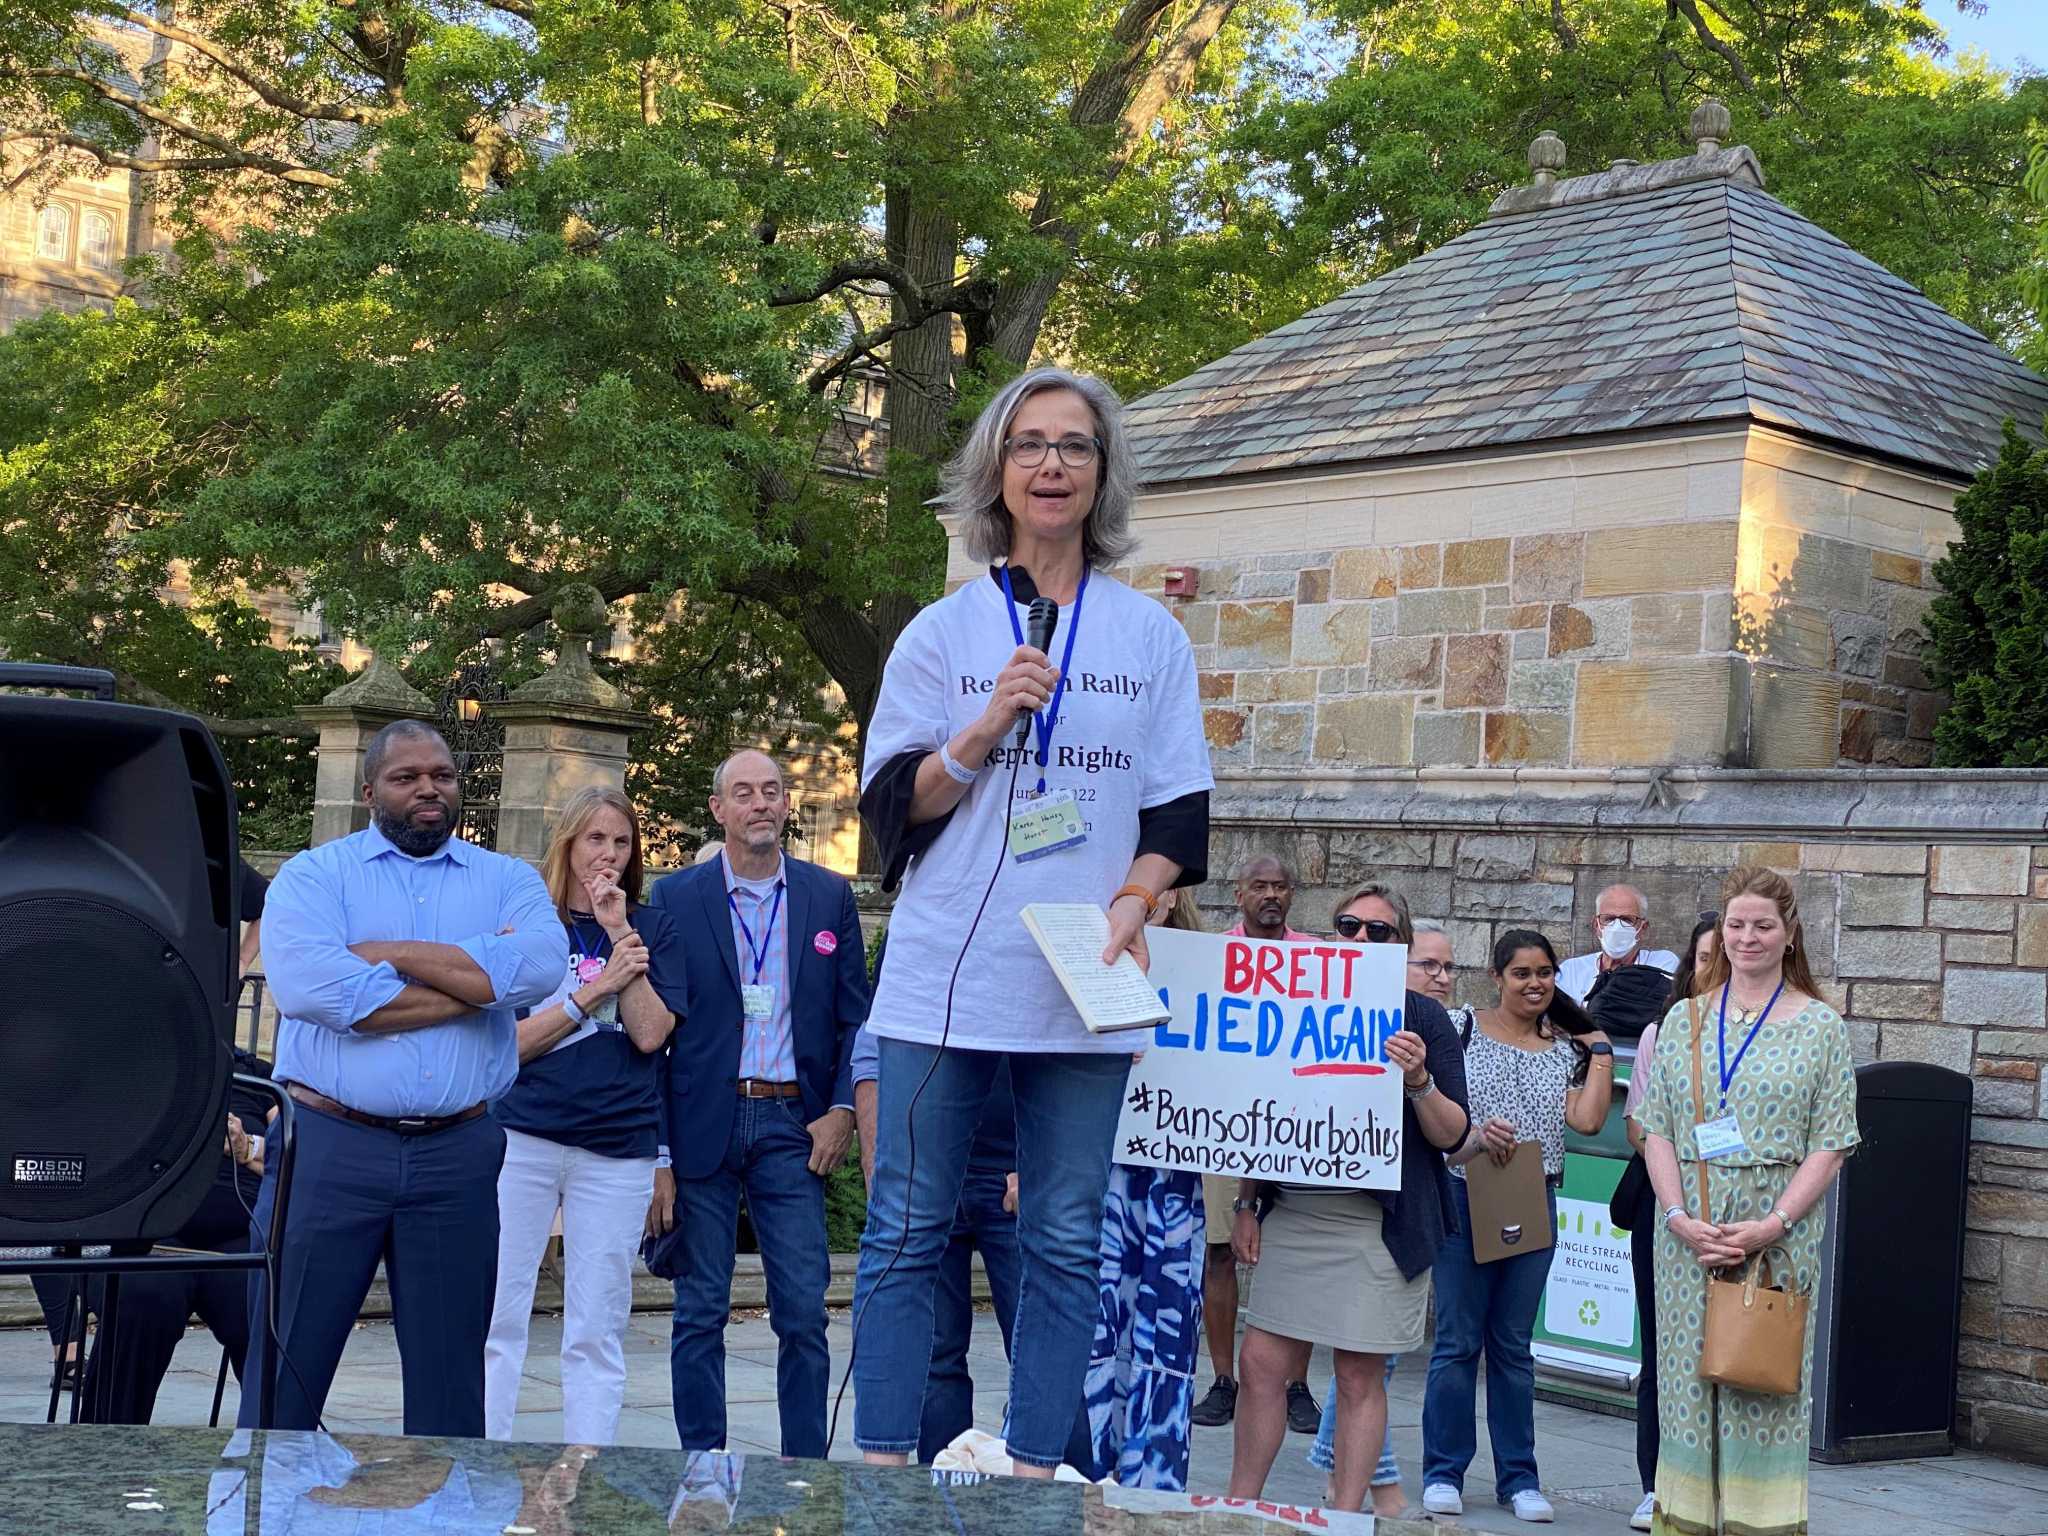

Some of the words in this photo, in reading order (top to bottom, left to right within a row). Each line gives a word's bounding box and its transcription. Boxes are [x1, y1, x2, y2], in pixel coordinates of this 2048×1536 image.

[1081, 672, 1143, 701] Rally
[1057, 745, 1132, 773] Rights
[1223, 941, 1363, 1001] BRETT
[1154, 986, 1284, 1057] LIED
[1290, 1003, 1402, 1064] AGAIN
[15, 1159, 83, 1171] EDISON
[14, 1174, 82, 1182] PROFESSIONAL
[1555, 1240, 1589, 1254] SINGLE
[1592, 1246, 1632, 1261] STREAM
[1565, 1257, 1619, 1274] RECYCLING
